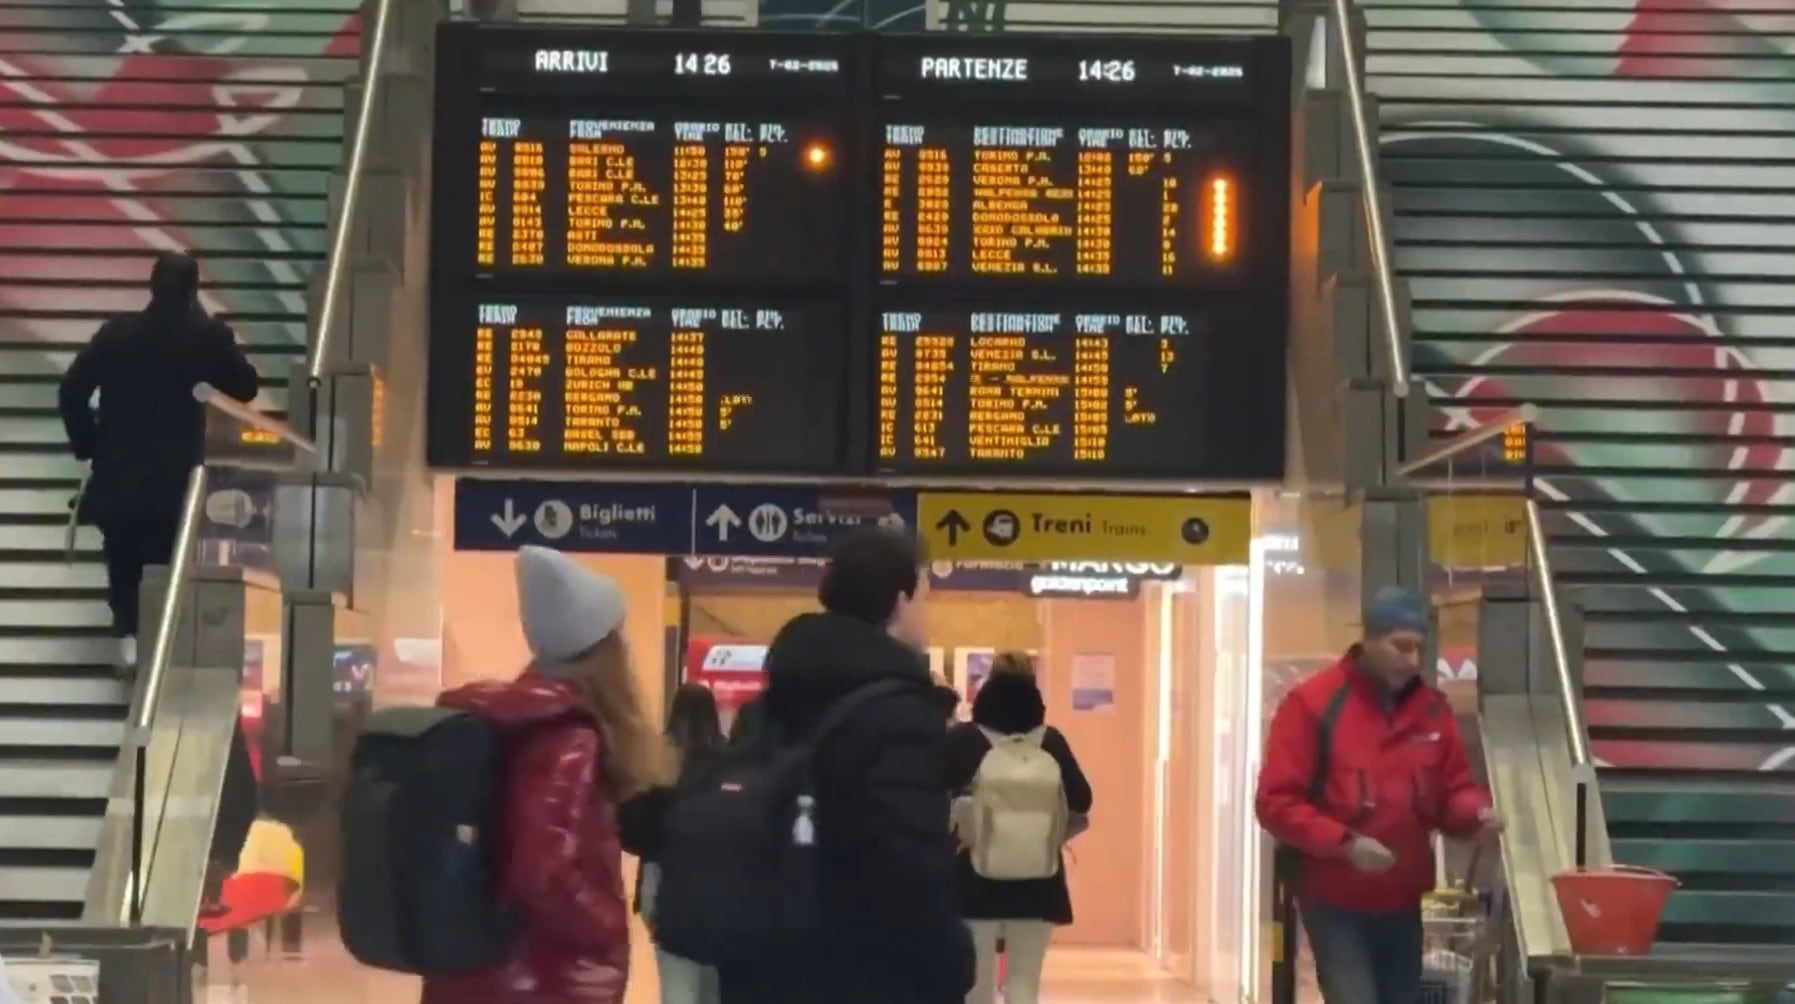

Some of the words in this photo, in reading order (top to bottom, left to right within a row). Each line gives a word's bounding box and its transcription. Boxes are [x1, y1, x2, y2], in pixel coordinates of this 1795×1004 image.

[535, 51, 608, 72] ARRIVI
[921, 57, 1028, 80] PARTENZE
[1079, 60, 1136, 81] 14:26
[580, 504, 655, 524] Biglietti
[1032, 513, 1091, 533] Treni
[1102, 519, 1147, 536] Trains
